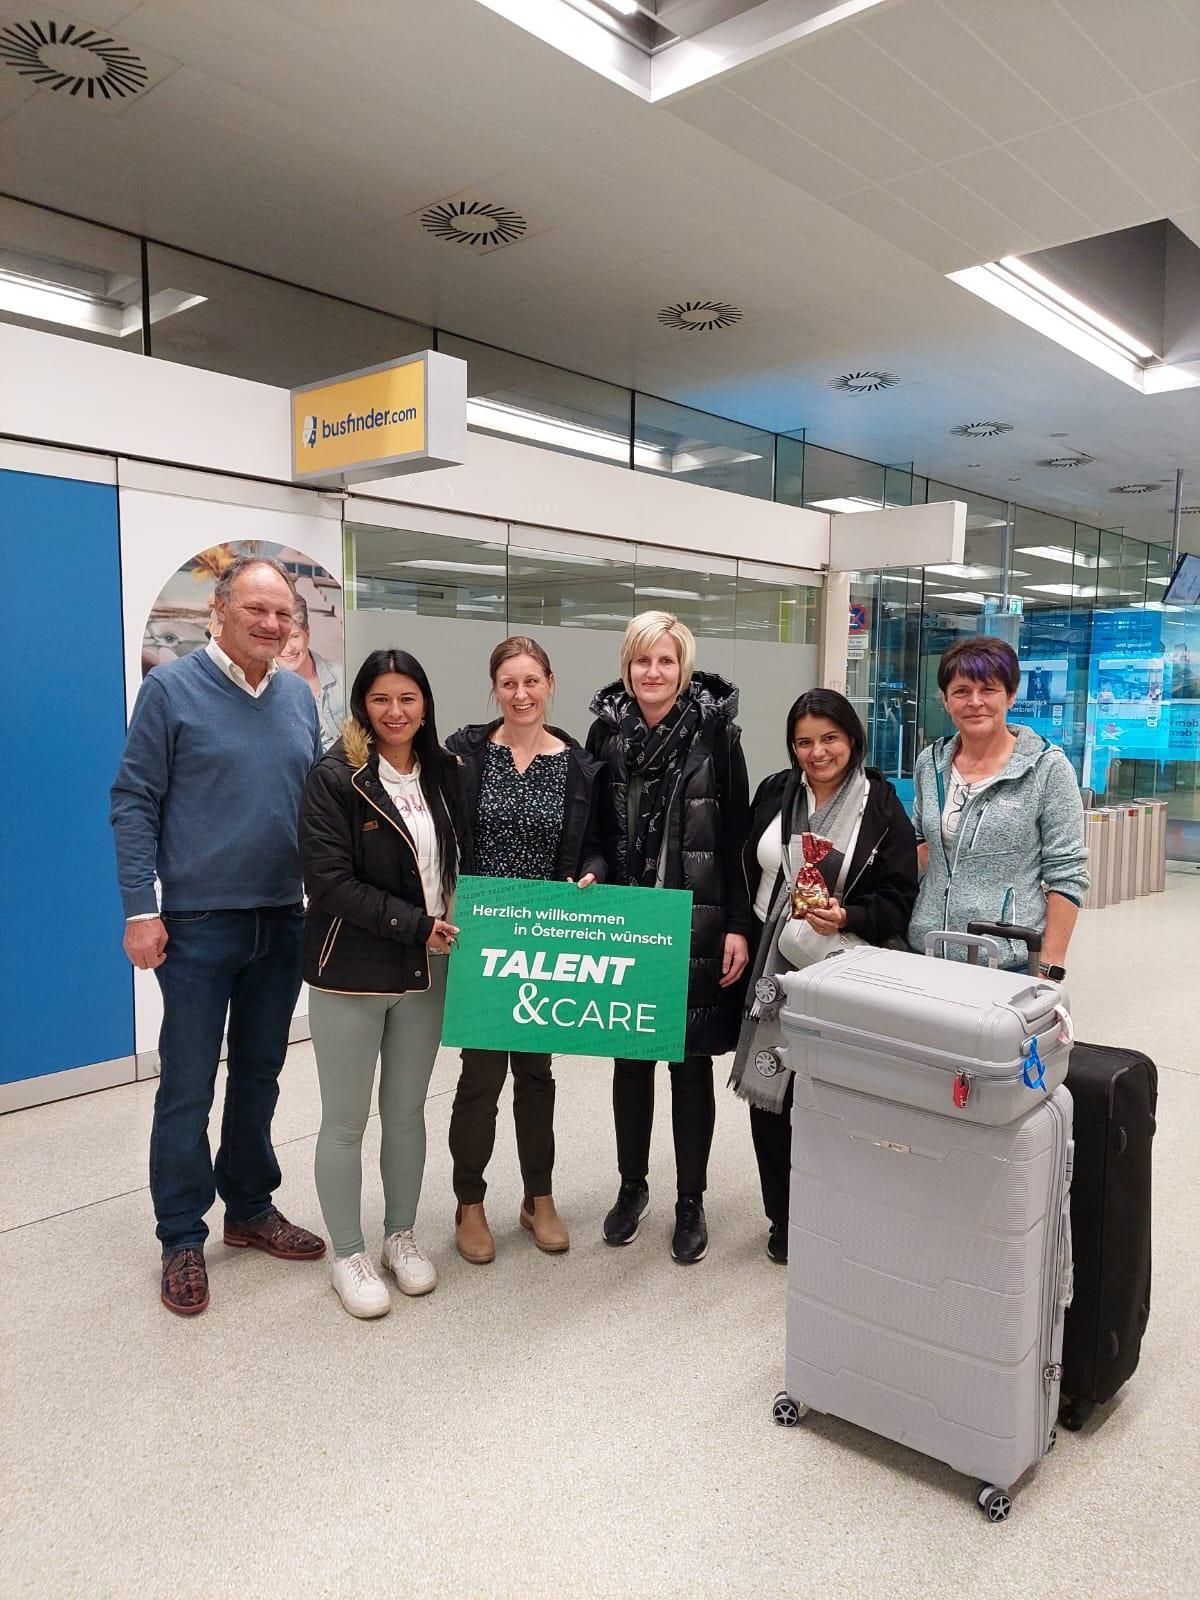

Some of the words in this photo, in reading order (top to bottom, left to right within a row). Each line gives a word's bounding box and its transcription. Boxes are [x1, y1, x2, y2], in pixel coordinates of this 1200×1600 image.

[322, 407, 417, 439] busfinder.com
[488, 885, 515, 895] TALENT
[473, 904, 532, 919] Herzlich
[535, 908, 625, 925] willkommen
[513, 922, 527, 936] in
[531, 922, 606, 941] Österreich
[610, 930, 673, 946] wünscht
[480, 948, 636, 986] TALENT
